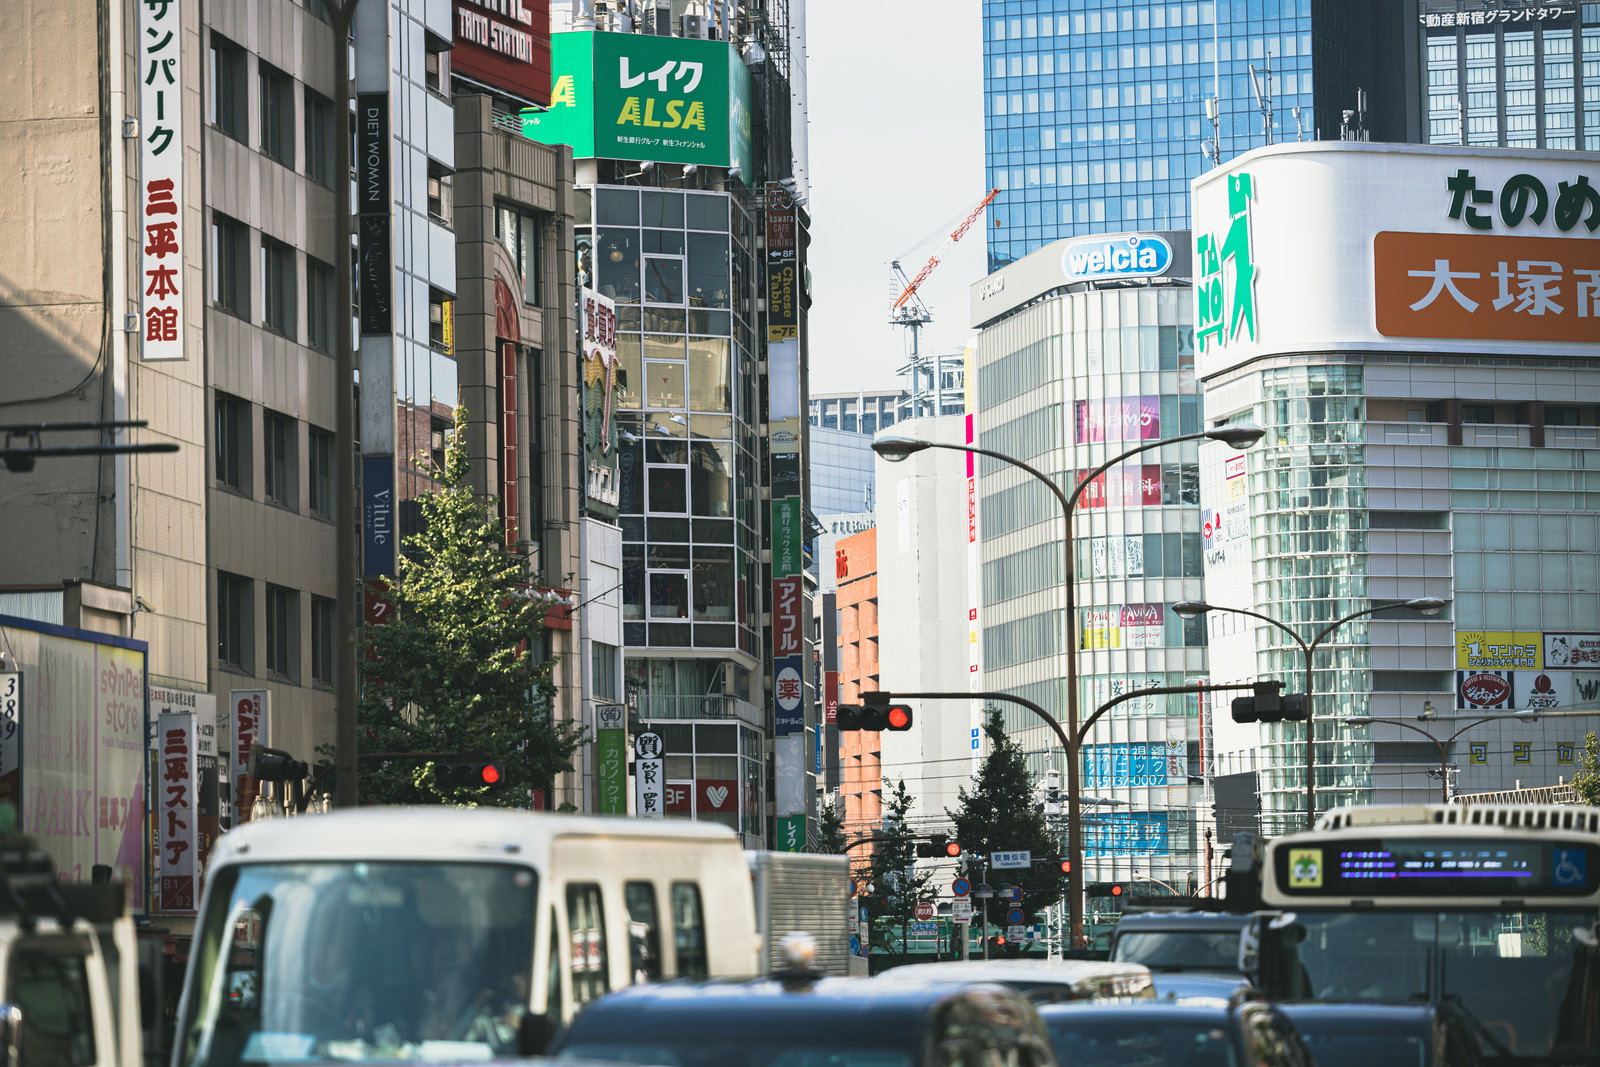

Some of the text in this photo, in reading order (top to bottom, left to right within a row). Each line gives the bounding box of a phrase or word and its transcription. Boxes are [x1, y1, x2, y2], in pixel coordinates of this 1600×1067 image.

[458, 7, 488, 47] TAITO
[491, 20, 532, 64] STATION
[619, 56, 703, 93] レイク
[616, 97, 706, 131] ALSA
[144, 0, 179, 342] サンパーク 三平本館
[367, 107, 380, 201] DIET WOMAN
[769, 239, 794, 247] DINING
[773, 224, 790, 233] CAFE
[782, 250, 795, 258] 8F
[1069, 237, 1158, 275] welcia
[771, 272, 782, 313] Table
[782, 266, 793, 318] Cheese
[781, 327, 795, 337] 7F
[373, 488, 390, 545] Vitule
[779, 582, 798, 651] アイフル
[1468, 657, 1536, 668] ひとりカラオケ専門店
[1488, 644, 1536, 657] ワンカラ
[778, 678, 800, 699] 薬
[1466, 685, 1505, 705] ジョナサン
[1526, 699, 1560, 708] バーミヤン
[5, 678, 16, 740] 389
[827, 700, 838, 719] ibis
[164, 728, 190, 865] 三平ストア
[787, 821, 797, 848] レイク
